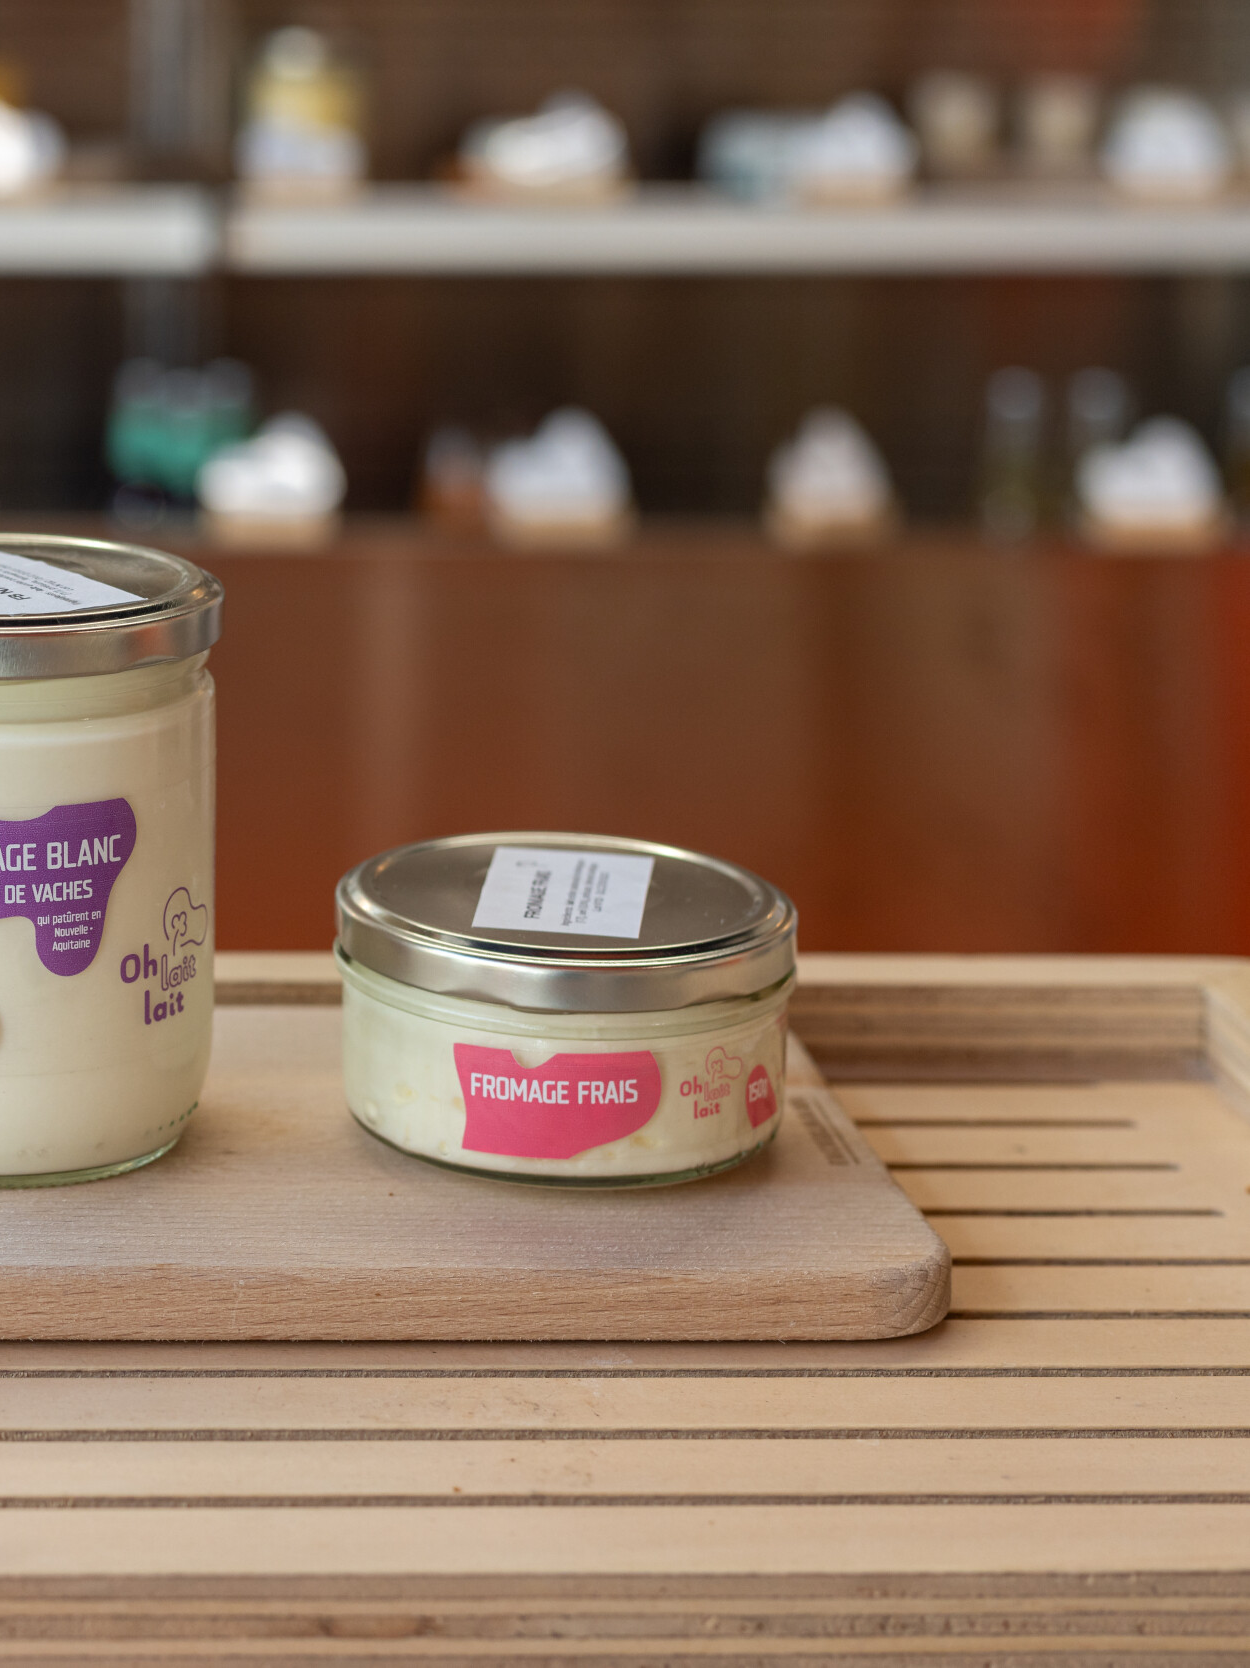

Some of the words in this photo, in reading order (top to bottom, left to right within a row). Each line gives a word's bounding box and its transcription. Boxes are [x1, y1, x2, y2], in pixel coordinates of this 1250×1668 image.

[47, 834, 121, 870] BLANC
[4, 884, 26, 904] DE
[32, 879, 93, 902] VACHES
[37, 914, 50, 927] qui
[52, 911, 90, 926] patûrent
[91, 910, 102, 920] en
[52, 939, 91, 953] Aquitaine
[120, 943, 158, 984] Oh
[161, 954, 196, 991] lait
[144, 990, 184, 1025] lait
[470, 1072, 570, 1105] FROMAGE
[577, 1079, 638, 1105] FRAIS
[679, 1075, 703, 1097] Oh
[693, 1100, 721, 1120] lait
